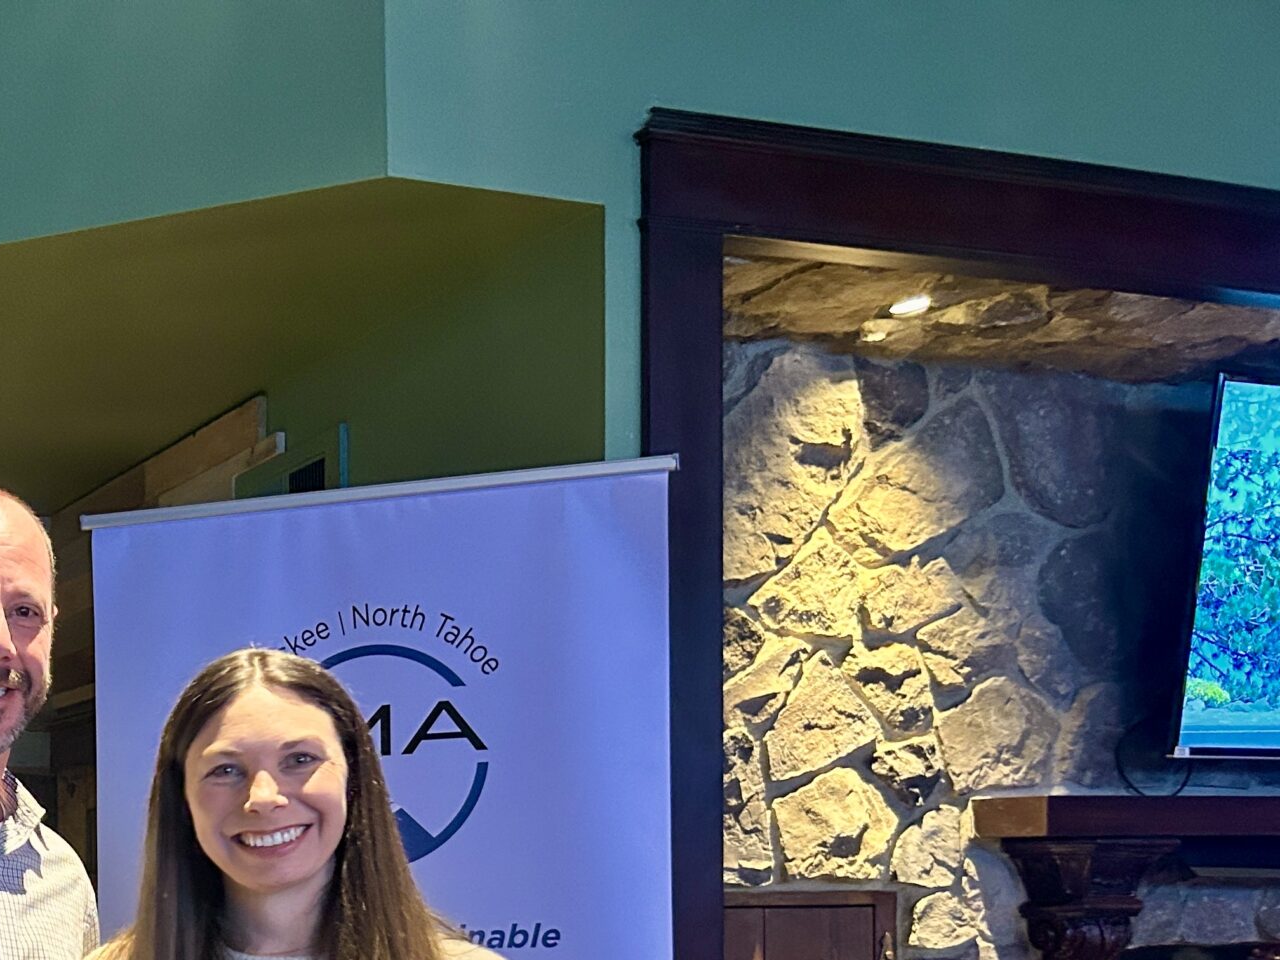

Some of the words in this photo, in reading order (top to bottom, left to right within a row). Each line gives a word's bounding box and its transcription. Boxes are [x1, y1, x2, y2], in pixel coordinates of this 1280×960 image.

[278, 621, 330, 656] kee
[352, 603, 426, 632] North
[434, 612, 500, 675] Tahoe
